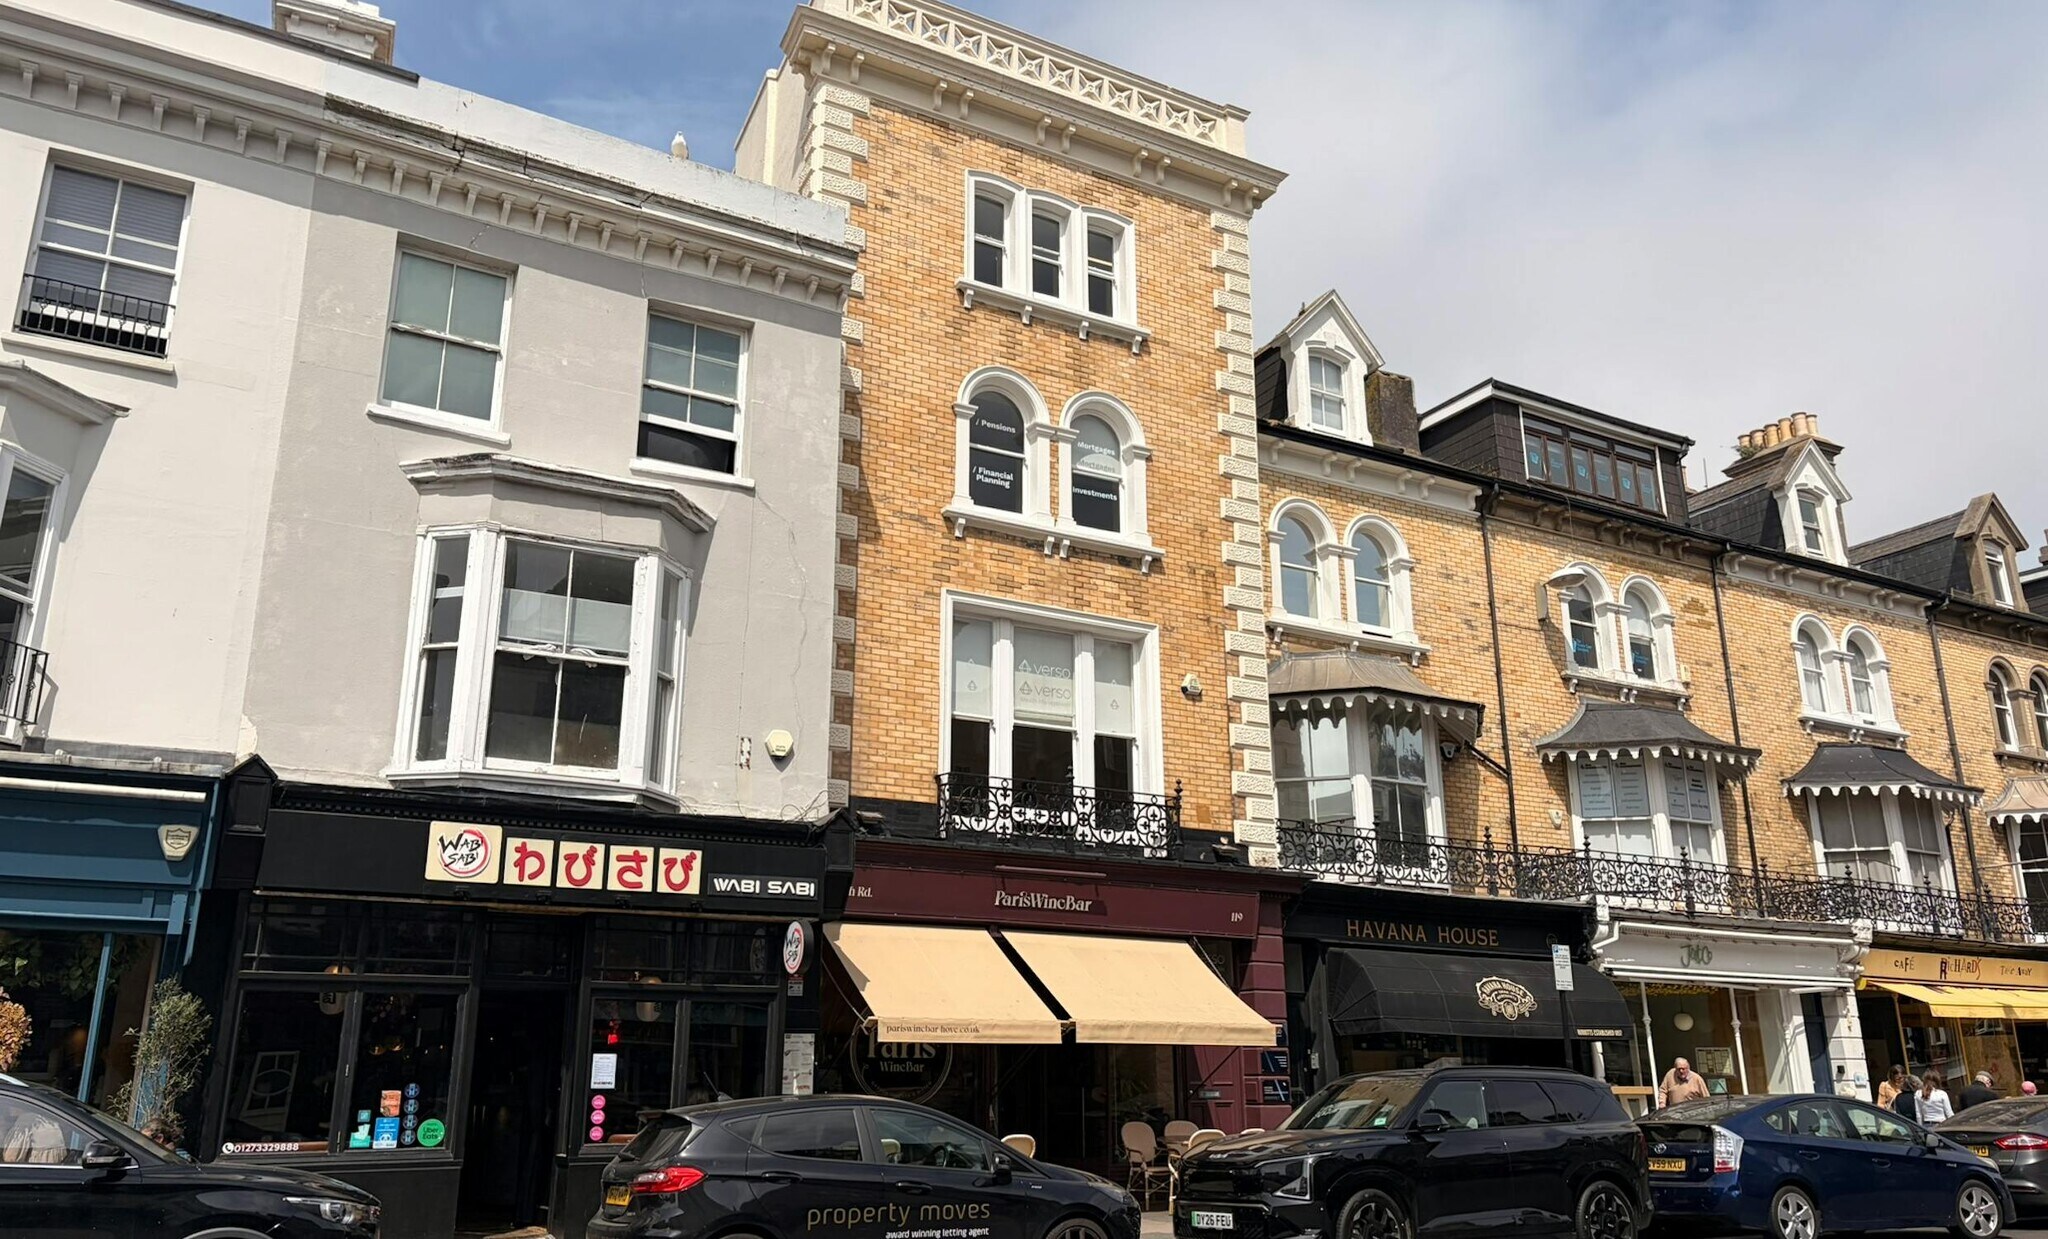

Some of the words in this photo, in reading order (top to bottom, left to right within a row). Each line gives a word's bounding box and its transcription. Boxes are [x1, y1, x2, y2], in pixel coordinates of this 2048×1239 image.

[981, 419, 1016, 434] Pensions
[1077, 441, 1116, 457] Mortgages
[978, 466, 1014, 481] Financial
[975, 474, 1011, 489] Planning
[1072, 486, 1118, 501] Investments
[1033, 664, 1071, 679] verso
[1034, 685, 1071, 699] verso
[514, 841, 697, 893] わびさび
[713, 877, 760, 894] WABI
[767, 880, 815, 897] SABI
[857, 886, 873, 898] Rd.
[1230, 912, 1243, 922] 119
[1347, 919, 1427, 943] HAVANA
[1438, 926, 1499, 947] HOUSE
[234, 1142, 299, 1153] 01273329888
[1667, 1160, 1683, 1169] NXU
[807, 1202, 911, 1231] property
[920, 1202, 991, 1221] moves
[1196, 1213, 1215, 1226] DY26
[1215, 1214, 1232, 1227] FEU
[885, 1230, 910, 1239] award
[911, 1229, 941, 1239] winning
[942, 1228, 967, 1238] letting
[968, 1227, 990, 1237] agent
